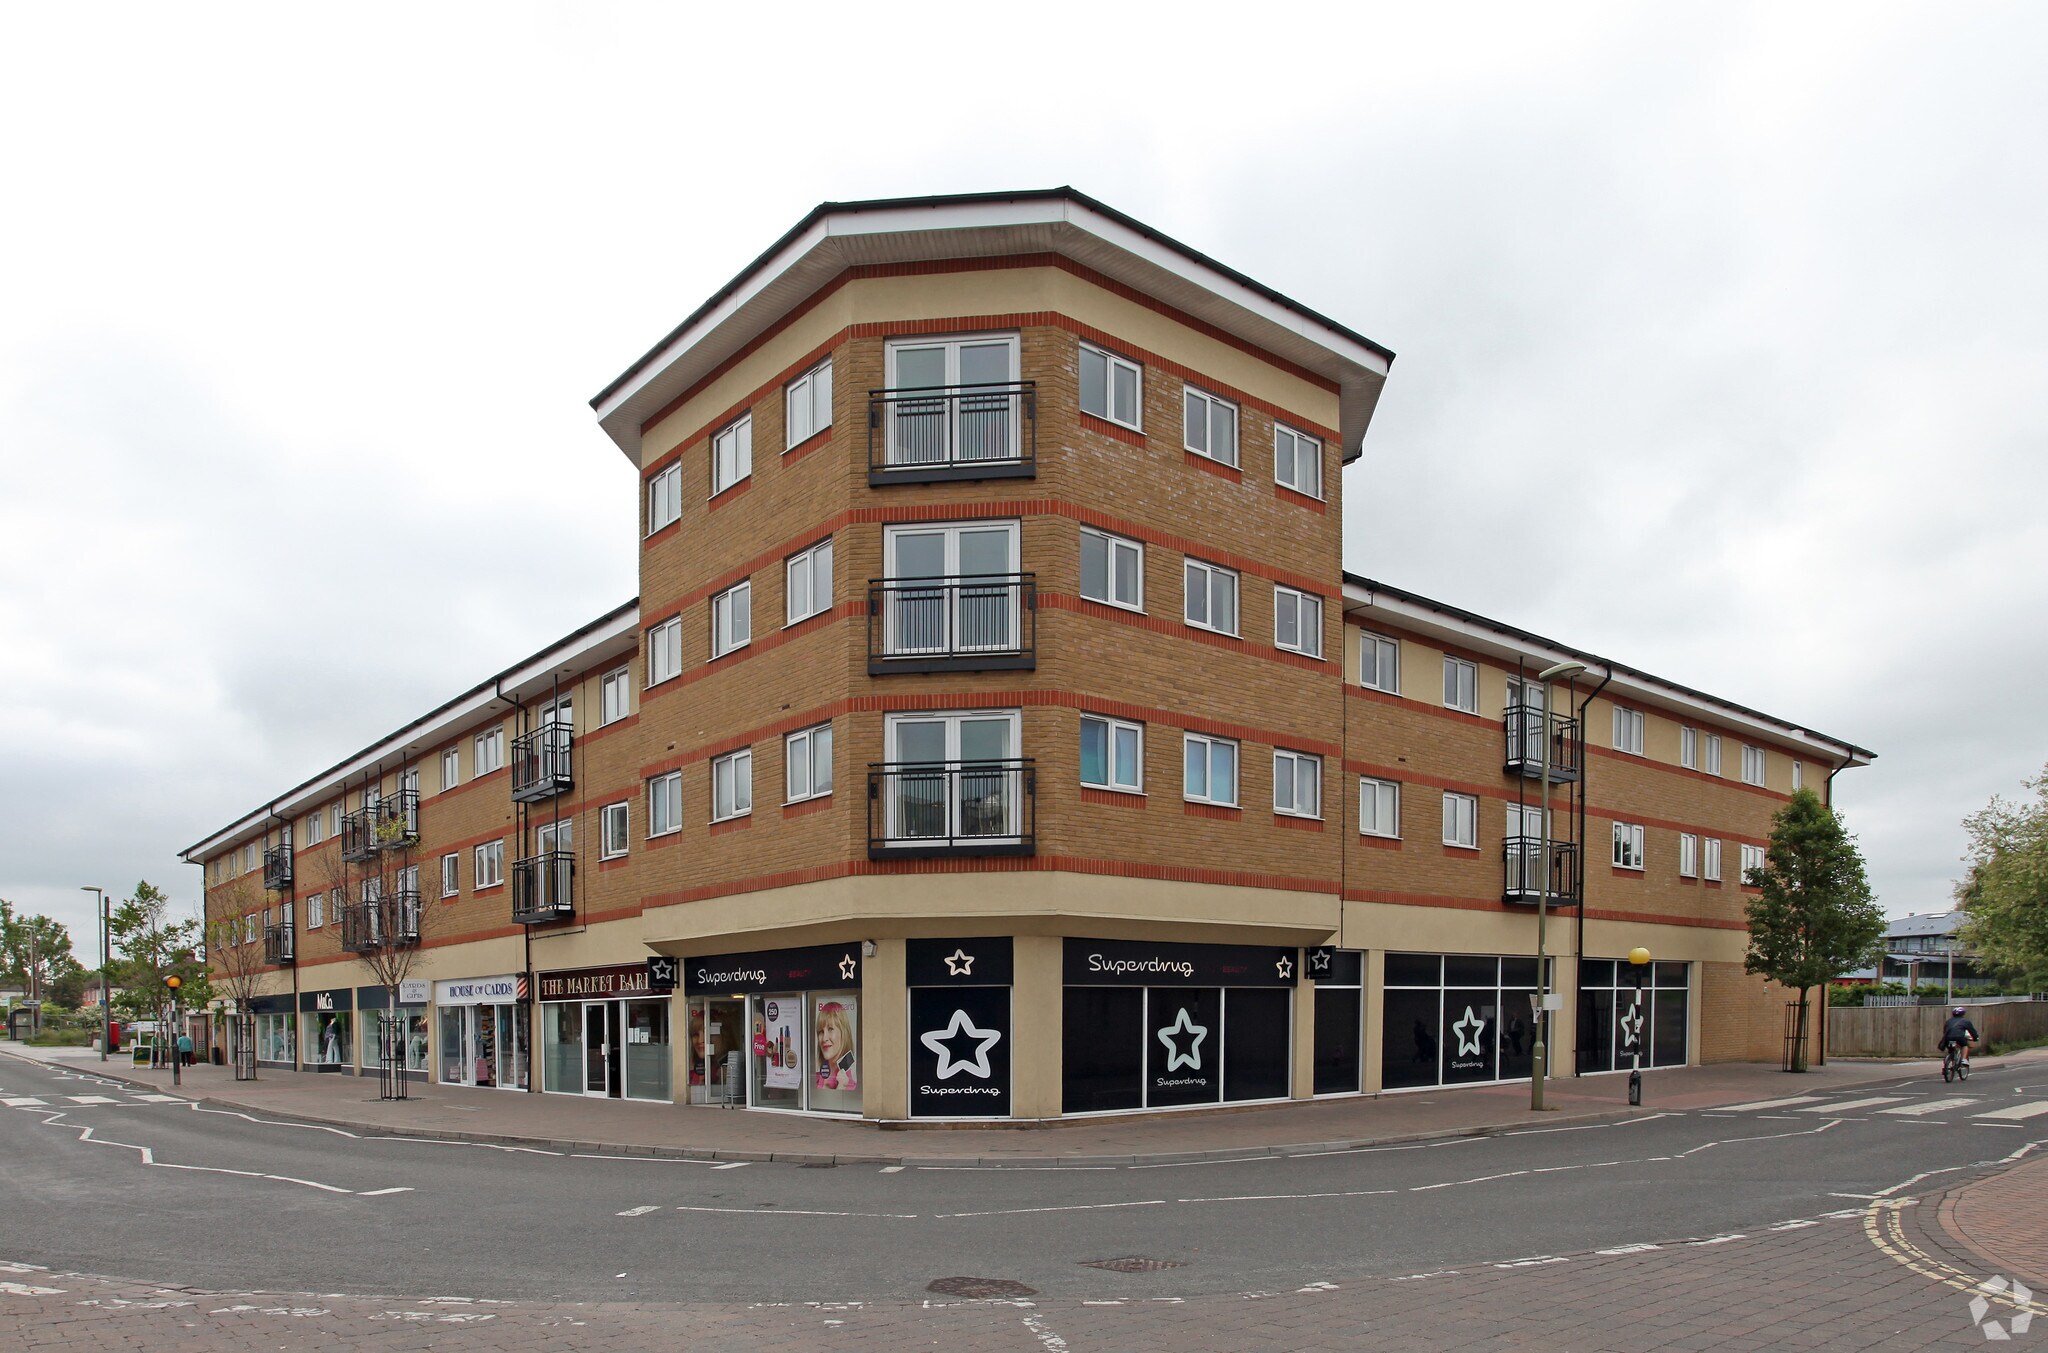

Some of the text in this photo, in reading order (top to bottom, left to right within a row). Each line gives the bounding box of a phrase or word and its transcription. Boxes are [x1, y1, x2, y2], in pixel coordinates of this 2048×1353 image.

[1088, 953, 1195, 978] Superdrug
[697, 967, 767, 986] Superdrug
[449, 982, 513, 998] HOUSE OF CARDS
[542, 978, 564, 996] THE
[567, 974, 615, 994] MARKET
[768, 1008, 777, 1016] 250
[753, 1042, 765, 1051] Free
[1451, 1061, 1484, 1069] Superdrug
[1156, 1077, 1207, 1087] Superdrug
[920, 1085, 1001, 1097] Superdrug
